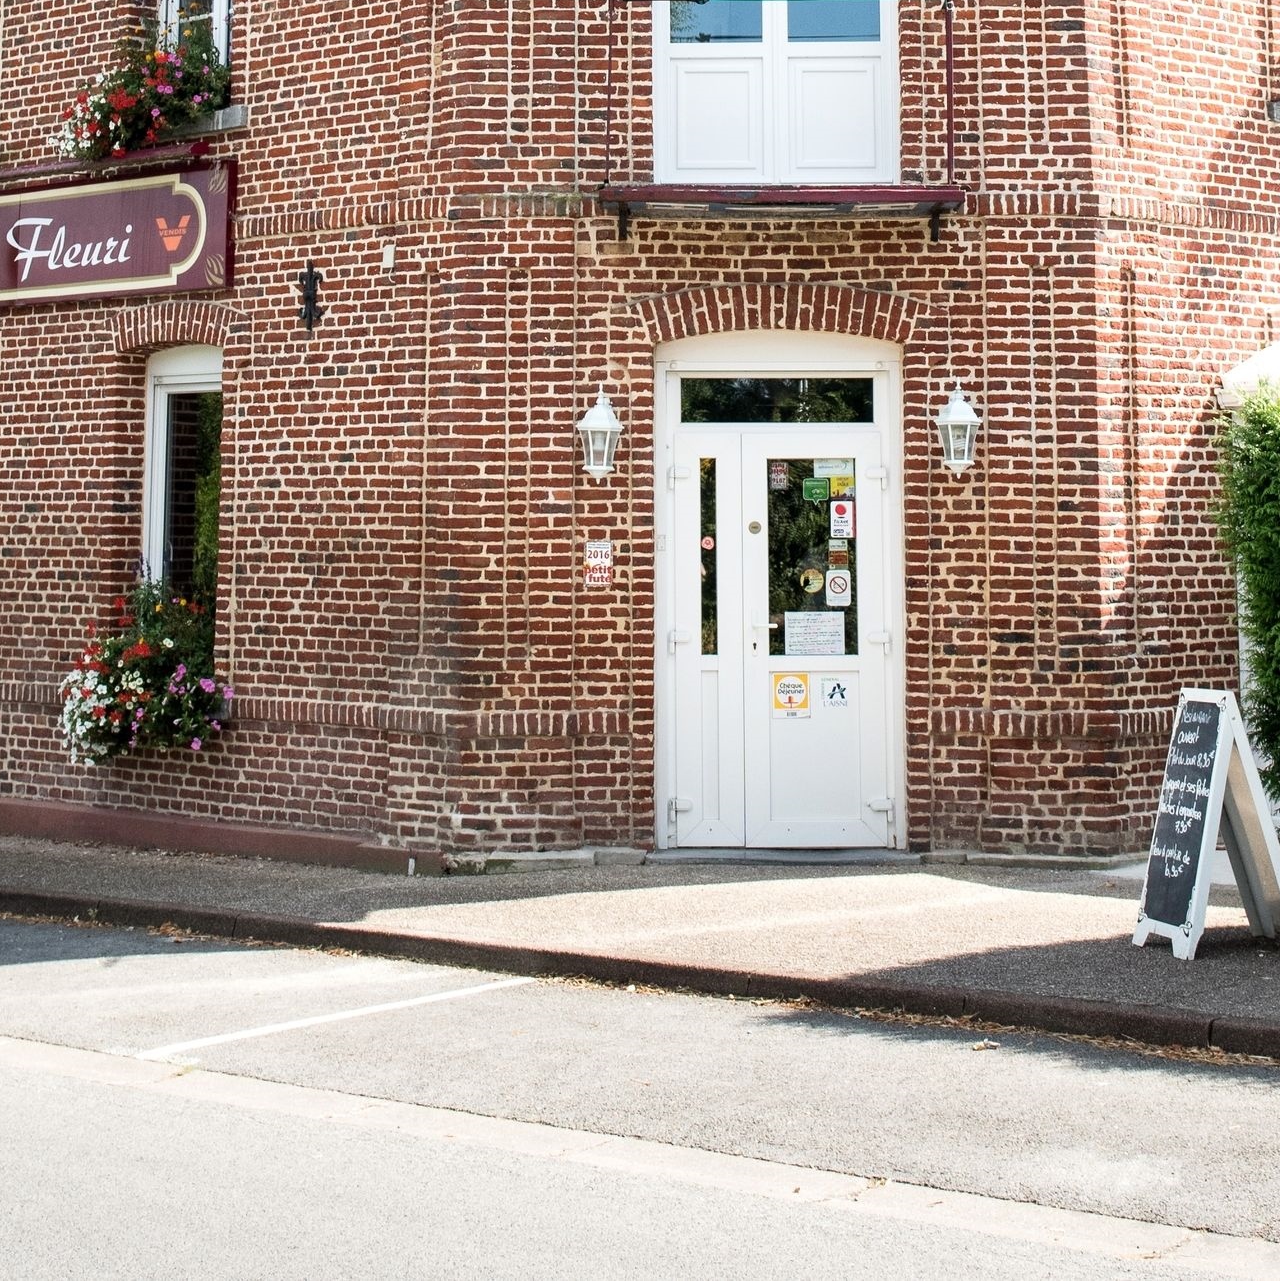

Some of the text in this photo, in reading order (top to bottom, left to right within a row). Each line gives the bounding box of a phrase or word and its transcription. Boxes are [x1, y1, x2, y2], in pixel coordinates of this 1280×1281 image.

[159, 228, 188, 237] VENDIS
[6, 217, 133, 283] Fleuri
[587, 549, 610, 560] 2016
